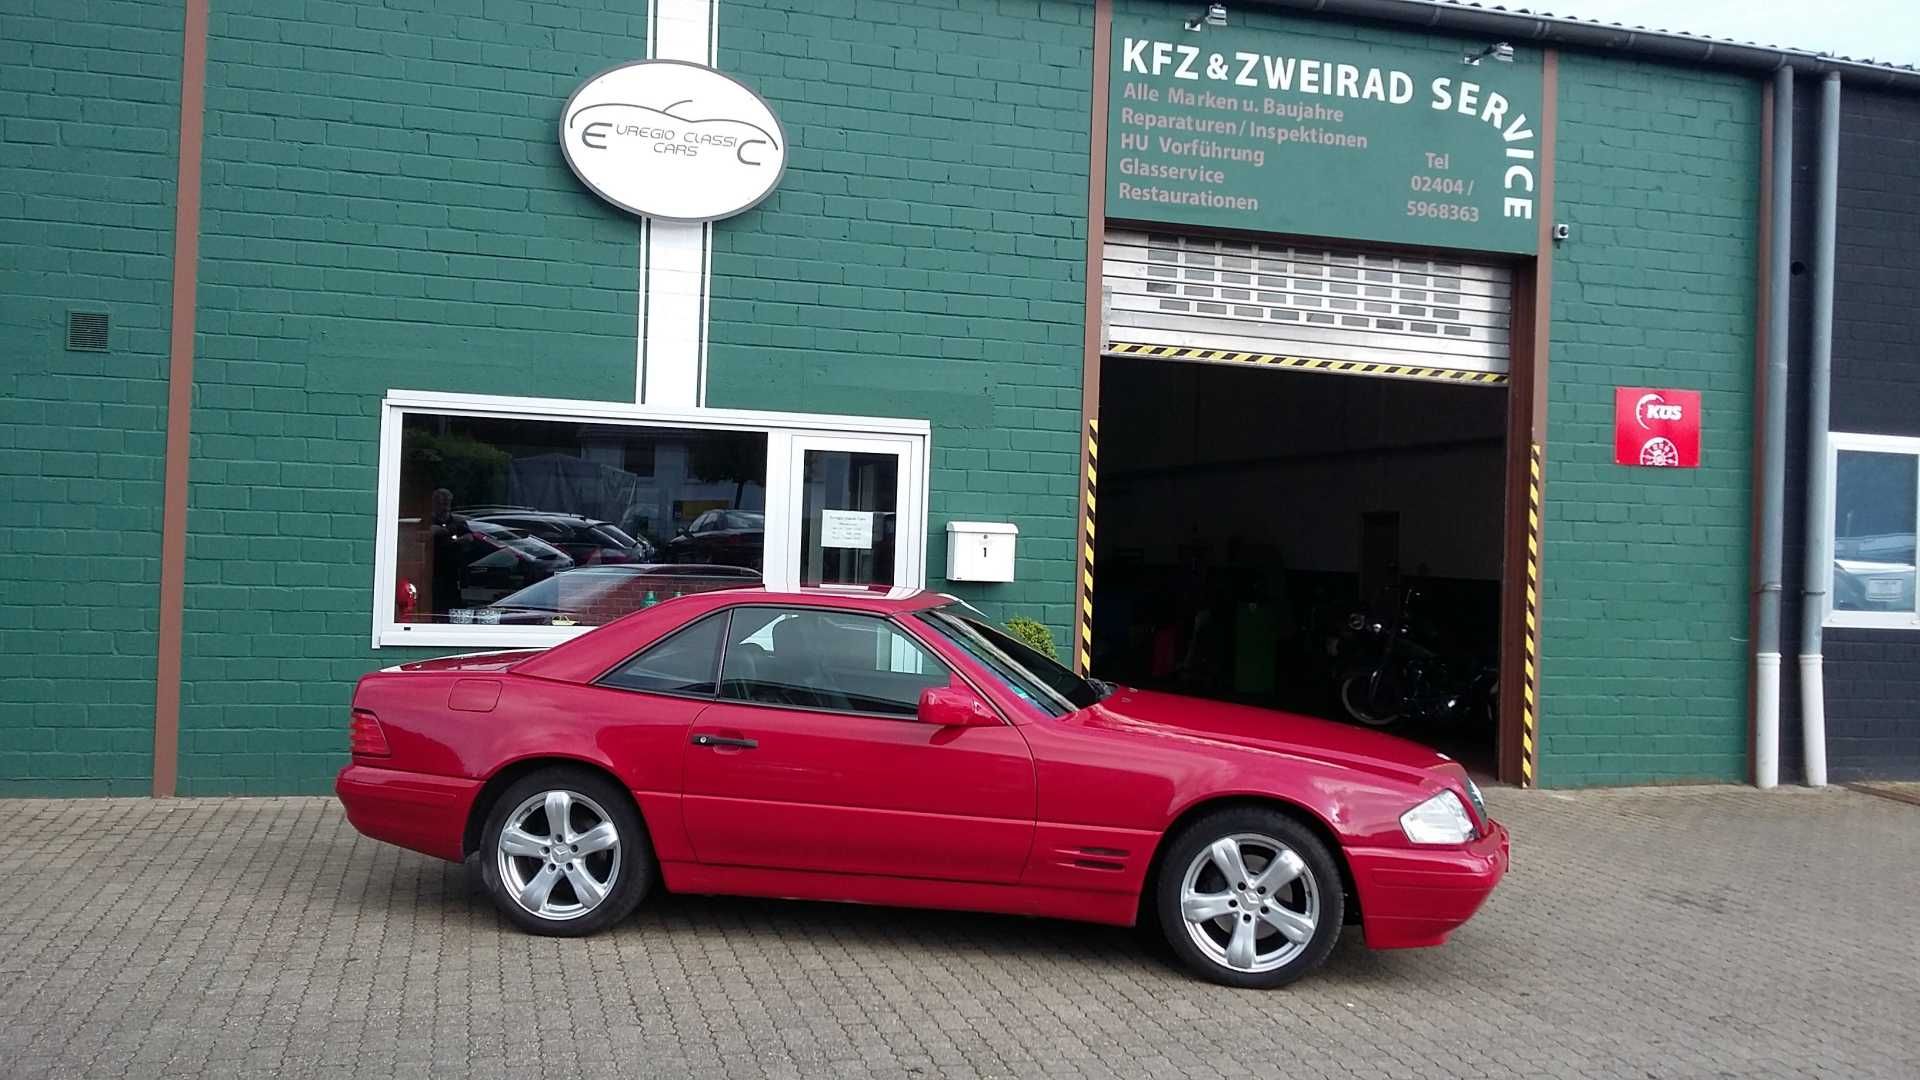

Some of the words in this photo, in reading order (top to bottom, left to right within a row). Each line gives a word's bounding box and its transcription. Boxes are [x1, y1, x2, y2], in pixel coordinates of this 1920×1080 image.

[1124, 82, 1159, 102] Alle
[1168, 88, 1238, 110] Marken
[1263, 97, 1345, 122] Baujahre
[1122, 38, 1200, 80] KFZ
[1206, 53, 1229, 81] &
[1235, 51, 1414, 105] ZWEIRAD
[1431, 77, 1535, 219] SERVICE
[653, 142, 698, 157] CARS
[1120, 132, 1149, 151] HU
[1159, 136, 1265, 167] Vorführung
[1425, 152, 1449, 169] Tel
[1119, 158, 1225, 183] Glasservice
[1118, 182, 1258, 211] Restaurationen
[1407, 200, 1479, 222] 5968363
